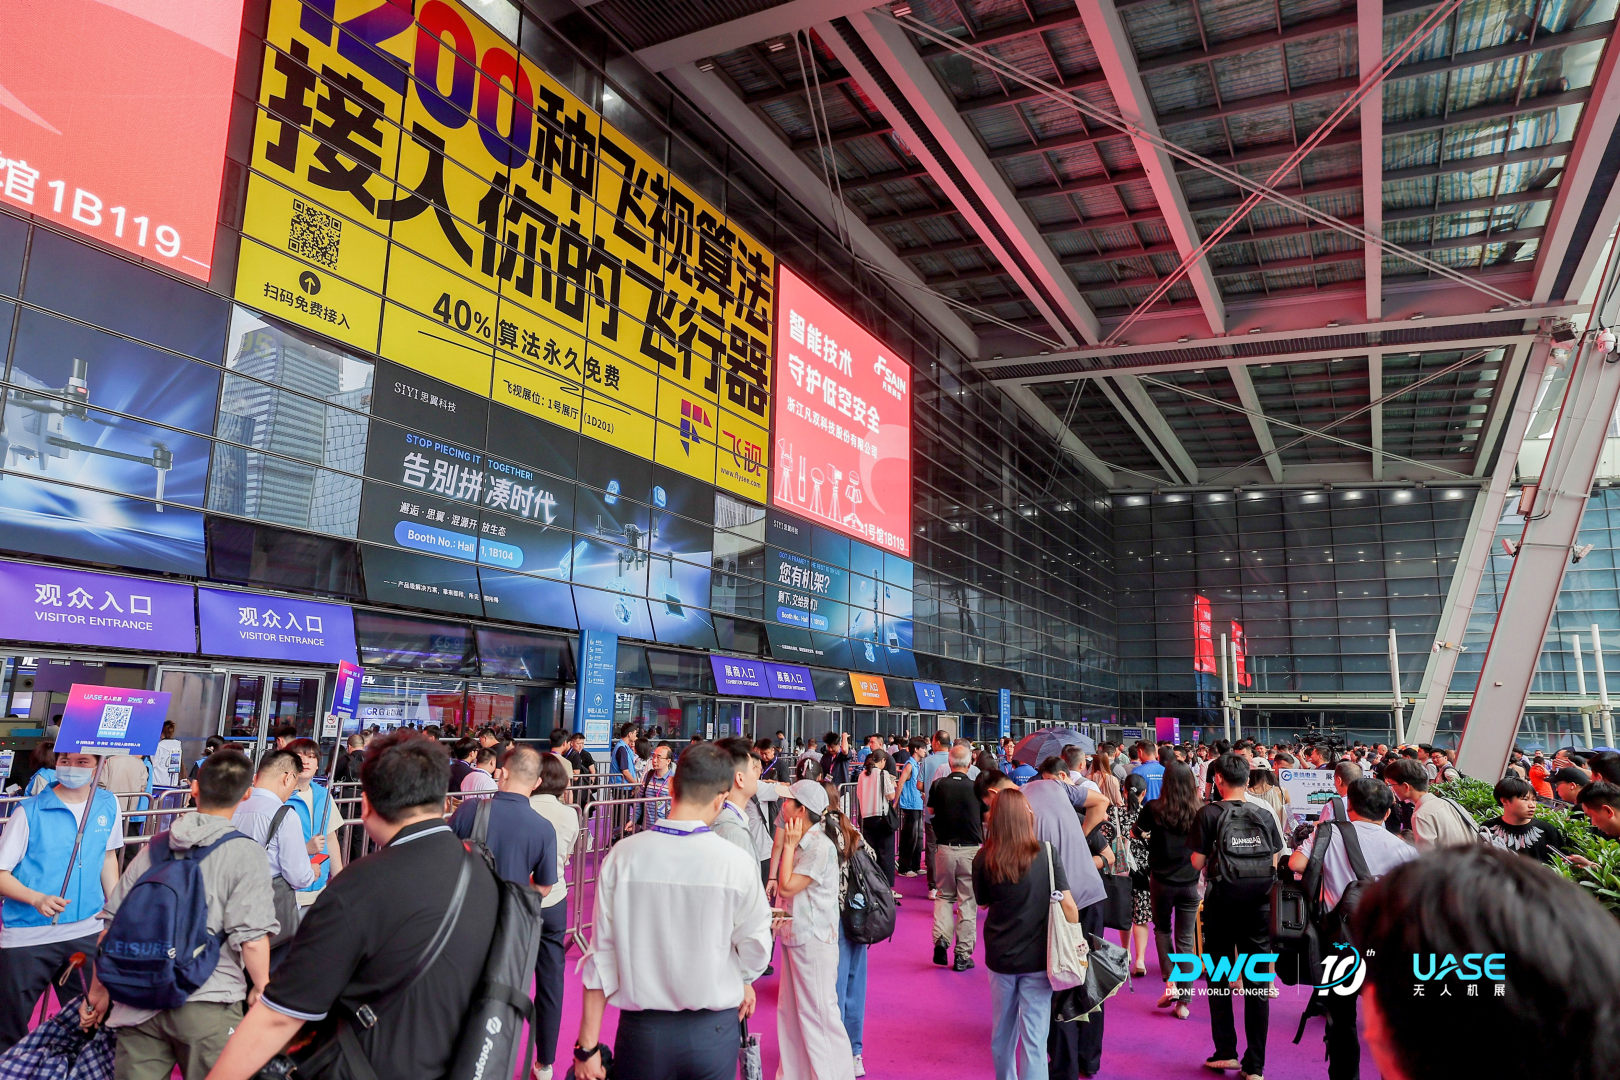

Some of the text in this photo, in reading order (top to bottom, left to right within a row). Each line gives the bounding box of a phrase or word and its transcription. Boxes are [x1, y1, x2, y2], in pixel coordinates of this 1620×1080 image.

[266, 38, 768, 417] 接入你的飞行器
[263, 281, 351, 330] 扫码免费接入
[432, 292, 621, 391] 40% 算法永久免费
[789, 308, 853, 378] 智能技术
[394, 382, 419, 400] SIYI
[788, 353, 881, 434] 守护低空安全
[406, 433, 533, 480] STOP PIECING IT TOGETHER!
[722, 429, 762, 477] 飞视
[403, 452, 556, 523] 告别拼凑时代
[720, 467, 761, 488] www.flysee.com
[407, 529, 436, 545] Booth
[457, 541, 475, 553] Hall
[489, 548, 513, 560] 1B104
[34, 582, 152, 616] 观众入口
[34, 611, 153, 631] VISITOR ENTRANCE
[238, 606, 323, 634] 观众入口
[239, 631, 325, 647] VISITOR ENTRANCE
[724, 664, 755, 679] 展商入口
[776, 671, 803, 684] 展商入口
